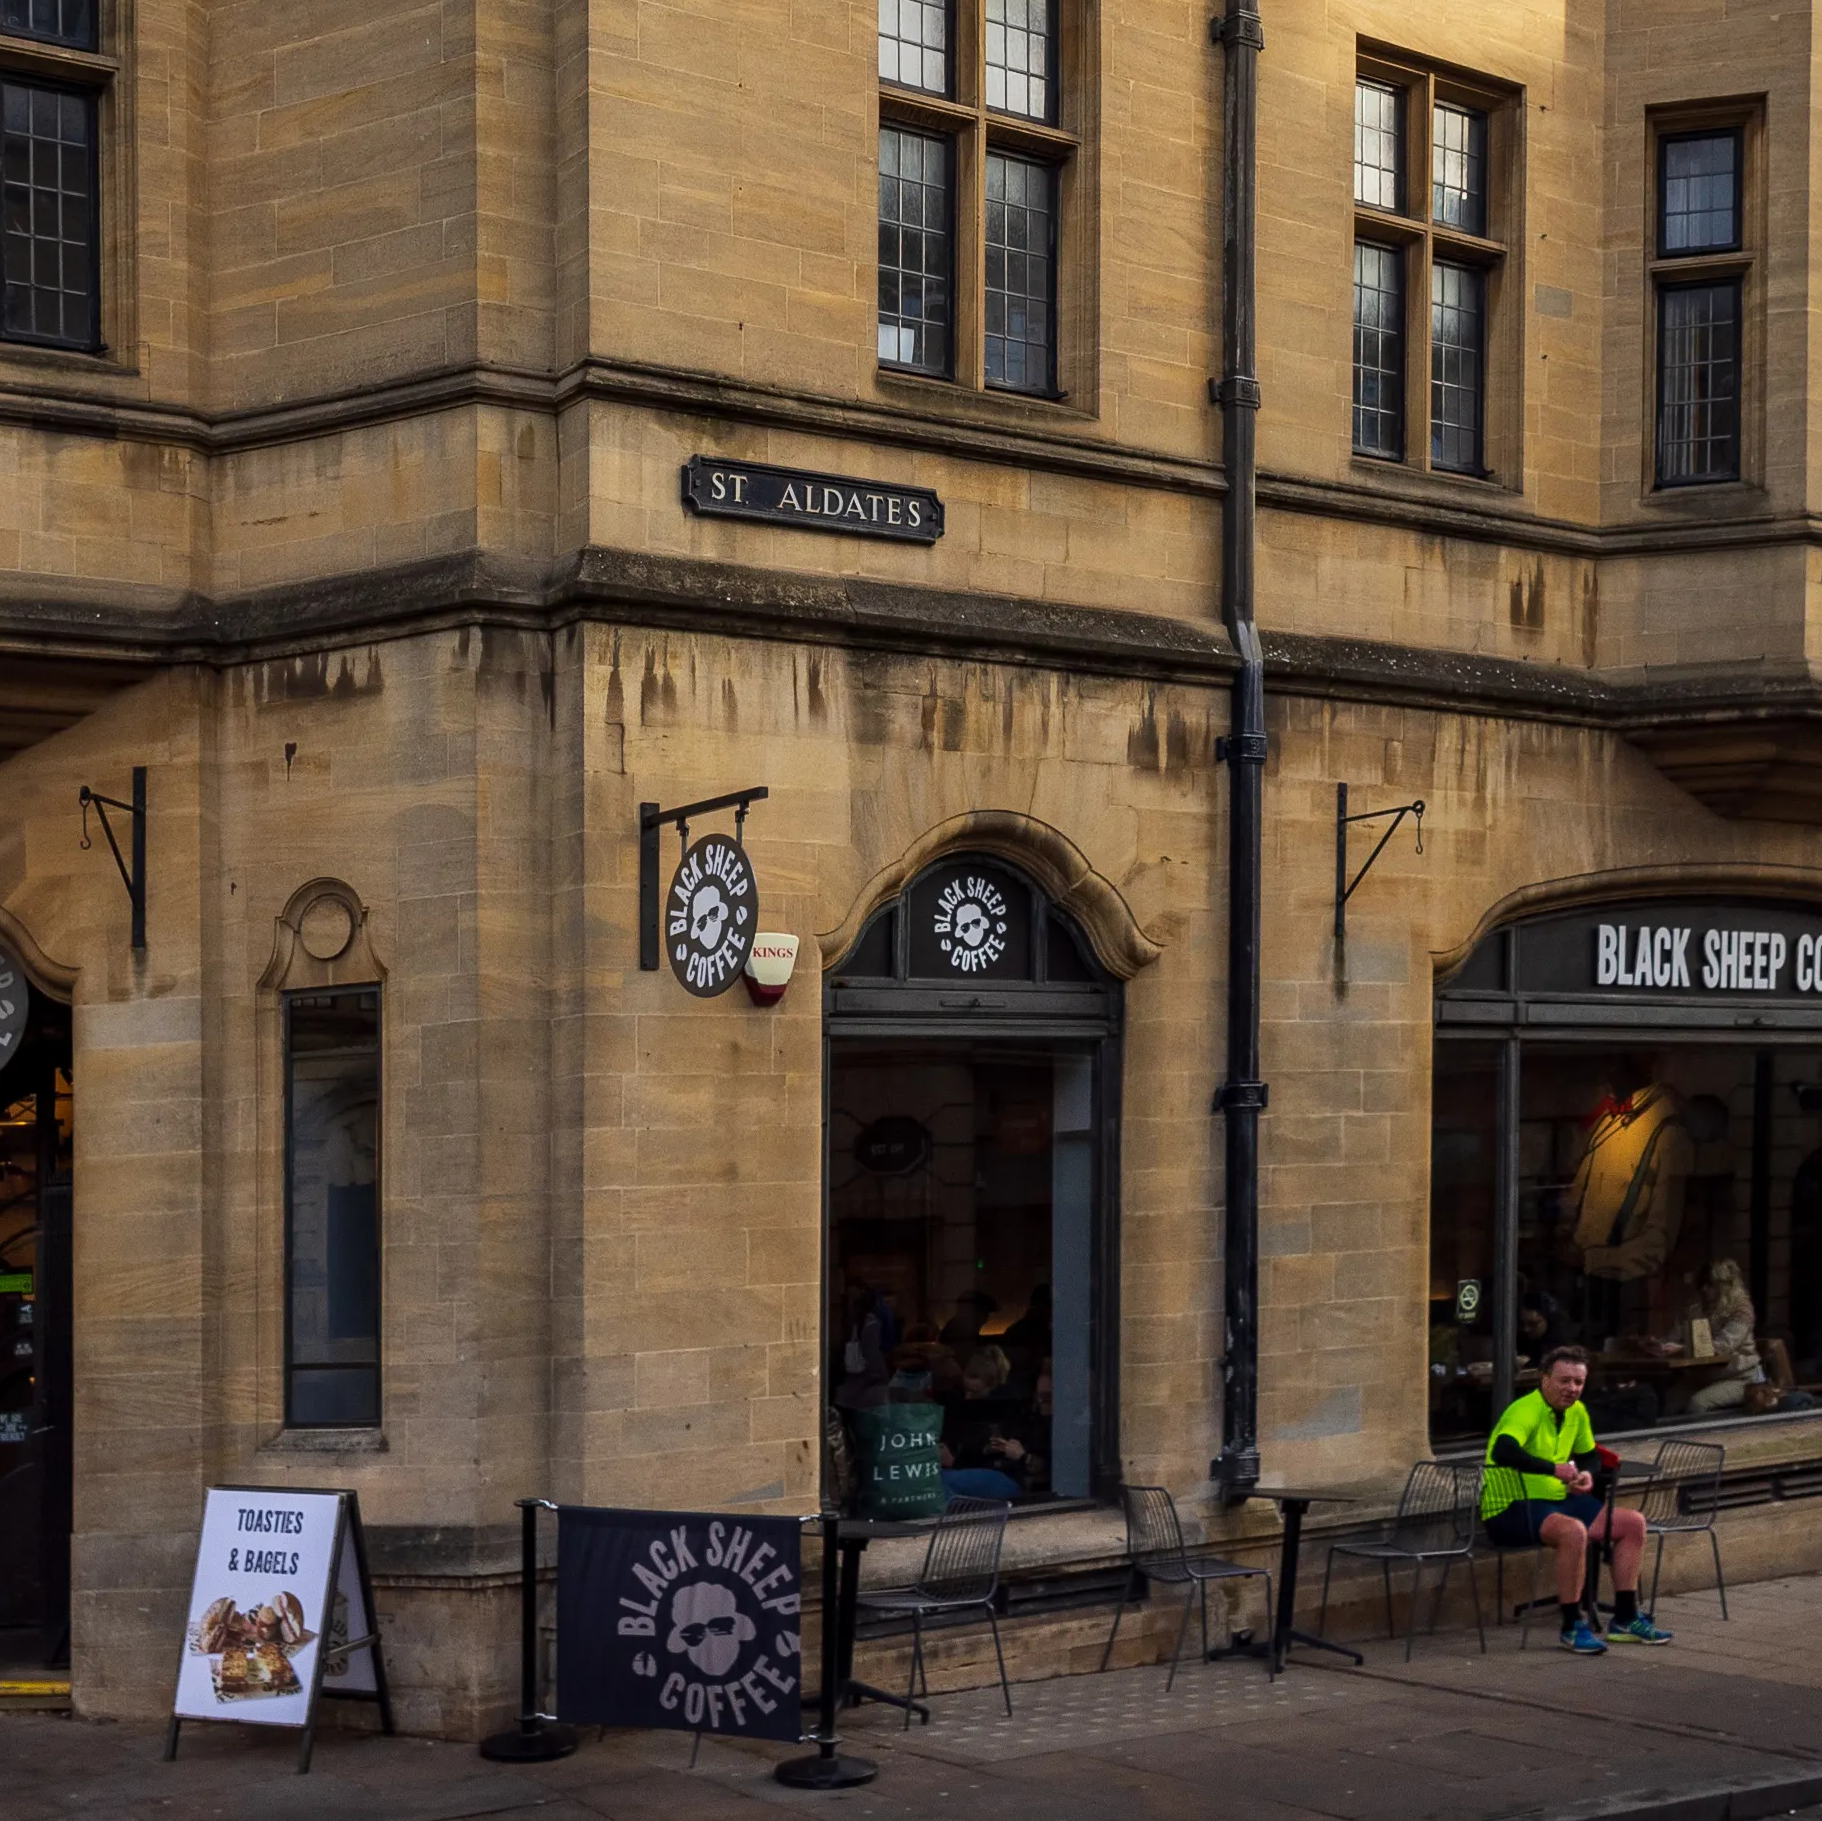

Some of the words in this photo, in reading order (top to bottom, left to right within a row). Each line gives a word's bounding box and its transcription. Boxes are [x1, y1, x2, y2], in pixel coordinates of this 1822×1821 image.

[669, 852, 704, 937] BLACK
[705, 844, 749, 898] SHEEP
[933, 878, 966, 934] BLACK
[966, 876, 1007, 916] SHEEP
[686, 926, 746, 989] COFFEE
[752, 947, 794, 959] KINGS
[950, 933, 1006, 973] COFFEE
[1596, 923, 1692, 989] BLACK
[1702, 928, 1787, 991] SHEEP
[879, 1432, 938, 1452] JOHN
[873, 1462, 940, 1482] LEWIS
[237, 1508, 304, 1535] TOASTIES
[227, 1547, 239, 1572] &
[243, 1549, 300, 1576] BAGELS
[617, 1525, 699, 1637] BLACK
[705, 1521, 801, 1616] SHEEP
[658, 1653, 798, 1729] COFFEE
